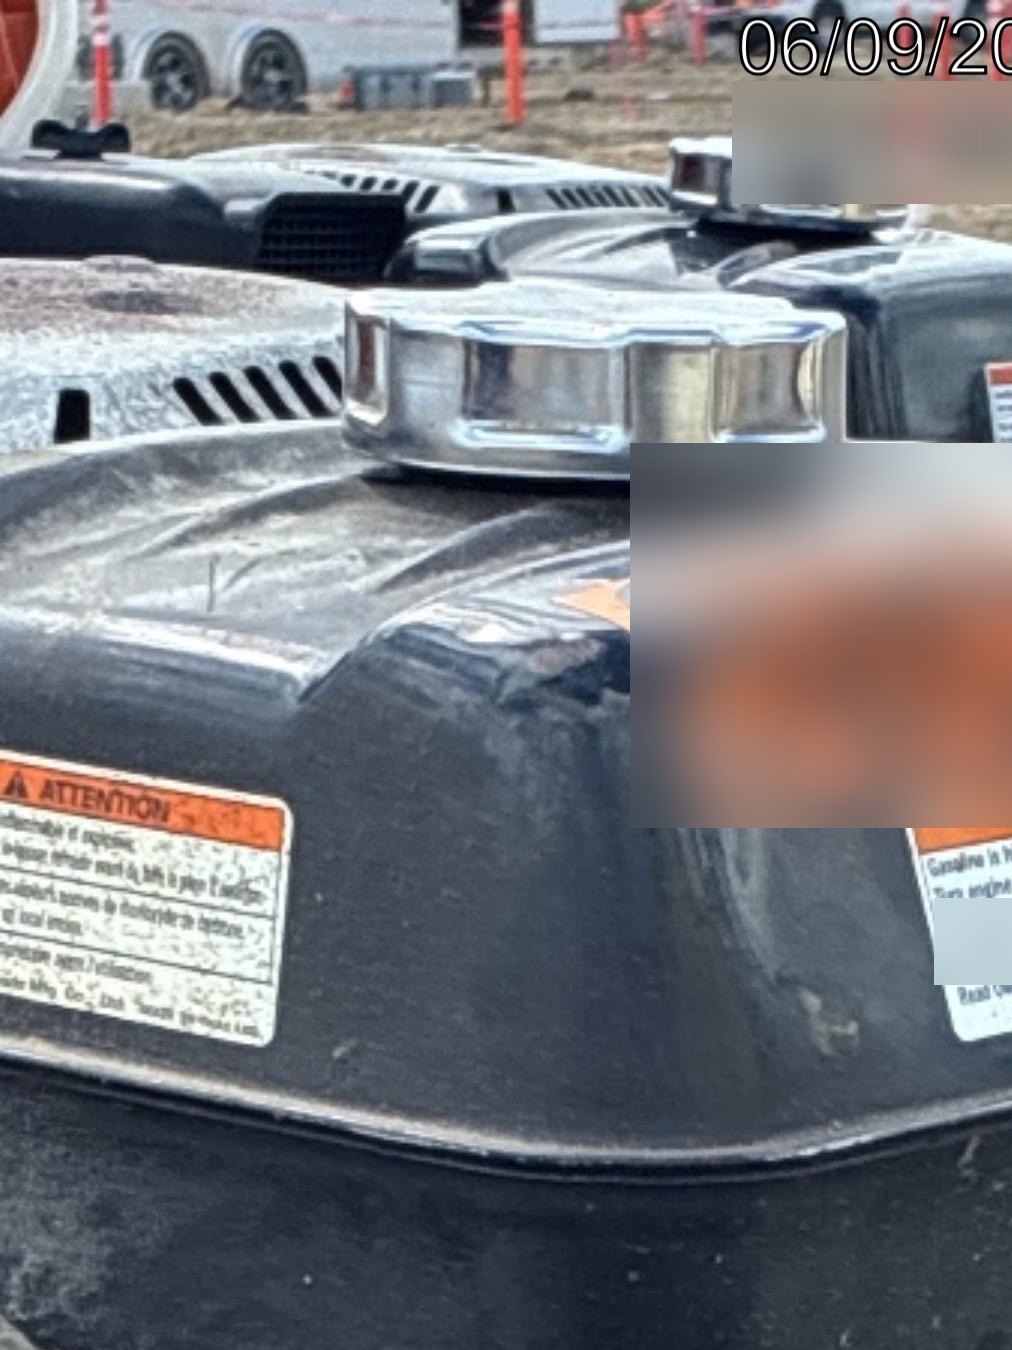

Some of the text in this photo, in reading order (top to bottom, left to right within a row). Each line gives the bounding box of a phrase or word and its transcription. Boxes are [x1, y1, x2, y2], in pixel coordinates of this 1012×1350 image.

[39, 779, 171, 823] ATTENTION
[928, 851, 985, 876] Gasoline
[988, 847, 1000, 866] is
[968, 876, 1012, 898] engine
